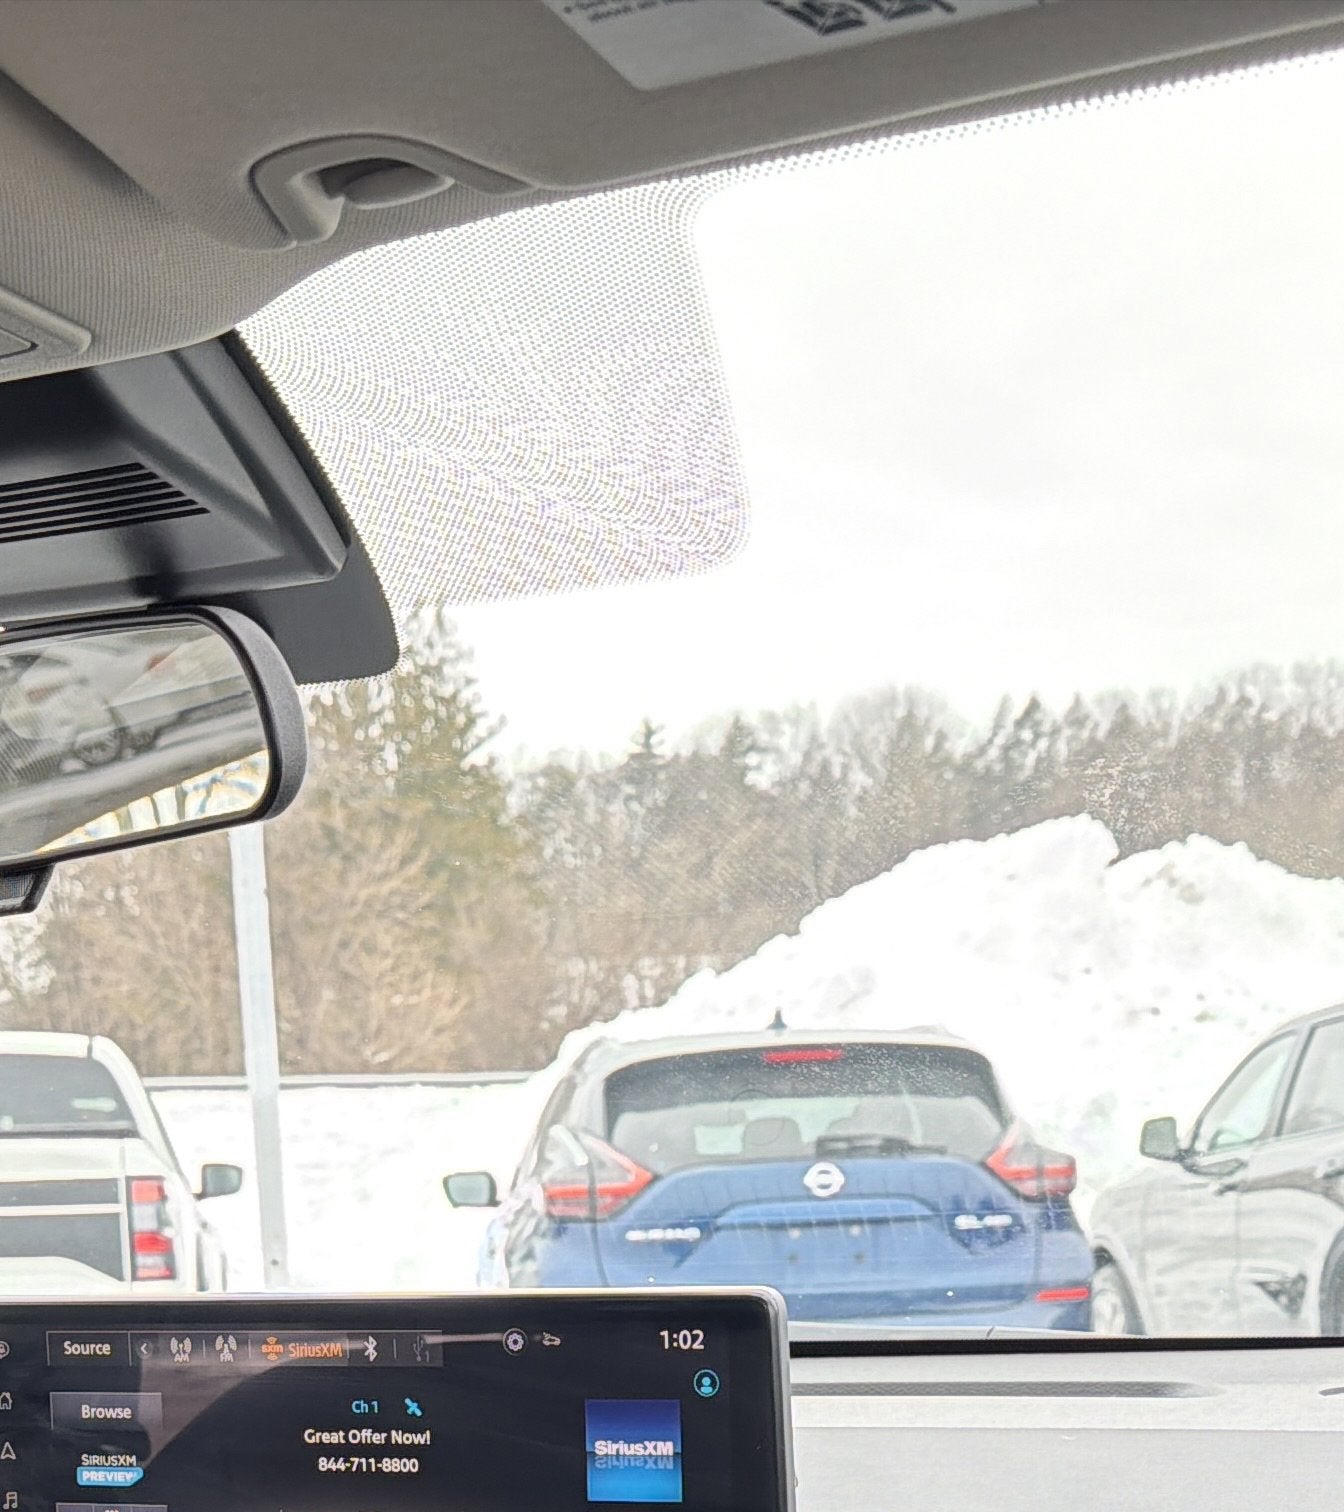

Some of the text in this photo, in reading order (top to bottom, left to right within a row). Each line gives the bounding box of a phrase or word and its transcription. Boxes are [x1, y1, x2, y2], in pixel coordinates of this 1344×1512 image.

[659, 1329, 705, 1350] 1:02
[63, 1340, 111, 1356] Source
[288, 1342, 344, 1359] SiriusXM
[173, 1354, 190, 1363] AM
[81, 1404, 132, 1420] Browse
[351, 1400, 379, 1414] Ch 1
[304, 1428, 431, 1446] Great Offer Now!
[594, 1440, 674, 1457] SiriusXM
[81, 1453, 137, 1467] SIRIUSXM
[318, 1456, 419, 1474] 844-711-8800
[82, 1470, 134, 1482] PREVIEW
